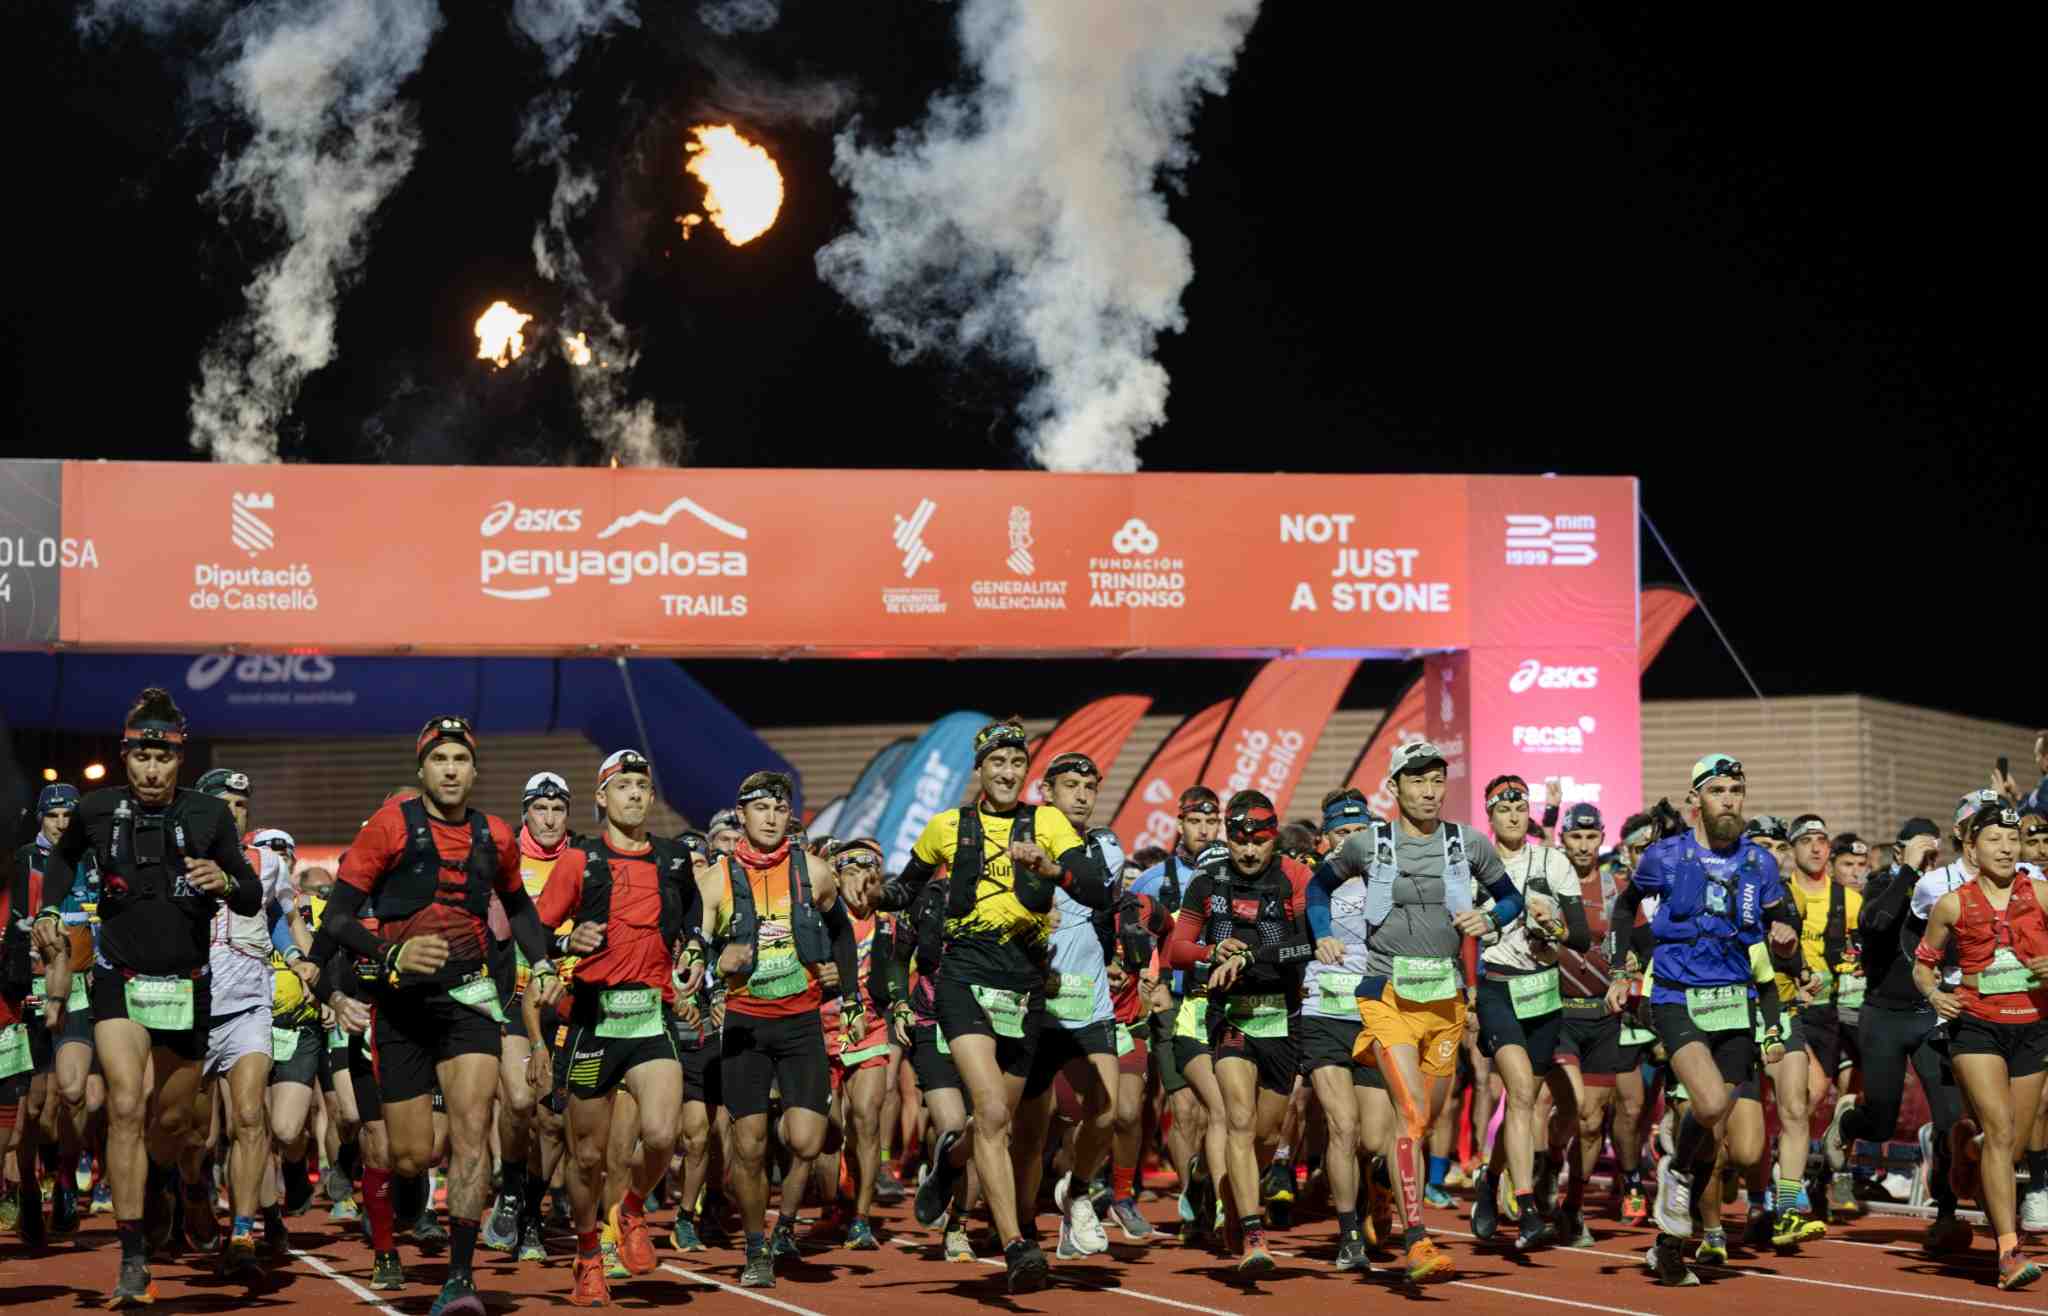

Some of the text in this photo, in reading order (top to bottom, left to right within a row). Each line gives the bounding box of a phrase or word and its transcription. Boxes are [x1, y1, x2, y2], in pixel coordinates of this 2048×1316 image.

[513, 506, 583, 532] asics
[1279, 513, 1355, 543] NOT
[0, 537, 98, 568] OLOSA
[480, 542, 748, 584] penyagolosa
[1089, 555, 1184, 569] FUNDACIÓN
[1332, 548, 1420, 577] JUST
[1506, 550, 1549, 566] 1999
[194, 563, 312, 591] Diputació
[970, 580, 1067, 594] GENERALITAT
[1088, 572, 1185, 589] TRINIDAD
[189, 587, 318, 610] de Castelló
[660, 595, 748, 616] TRAILS
[972, 596, 1067, 610] VALENCIANA
[1089, 591, 1185, 608] ALFONSO
[1289, 582, 1451, 612] A STONE
[236, 655, 336, 682] asics
[1538, 666, 1598, 688] asics
